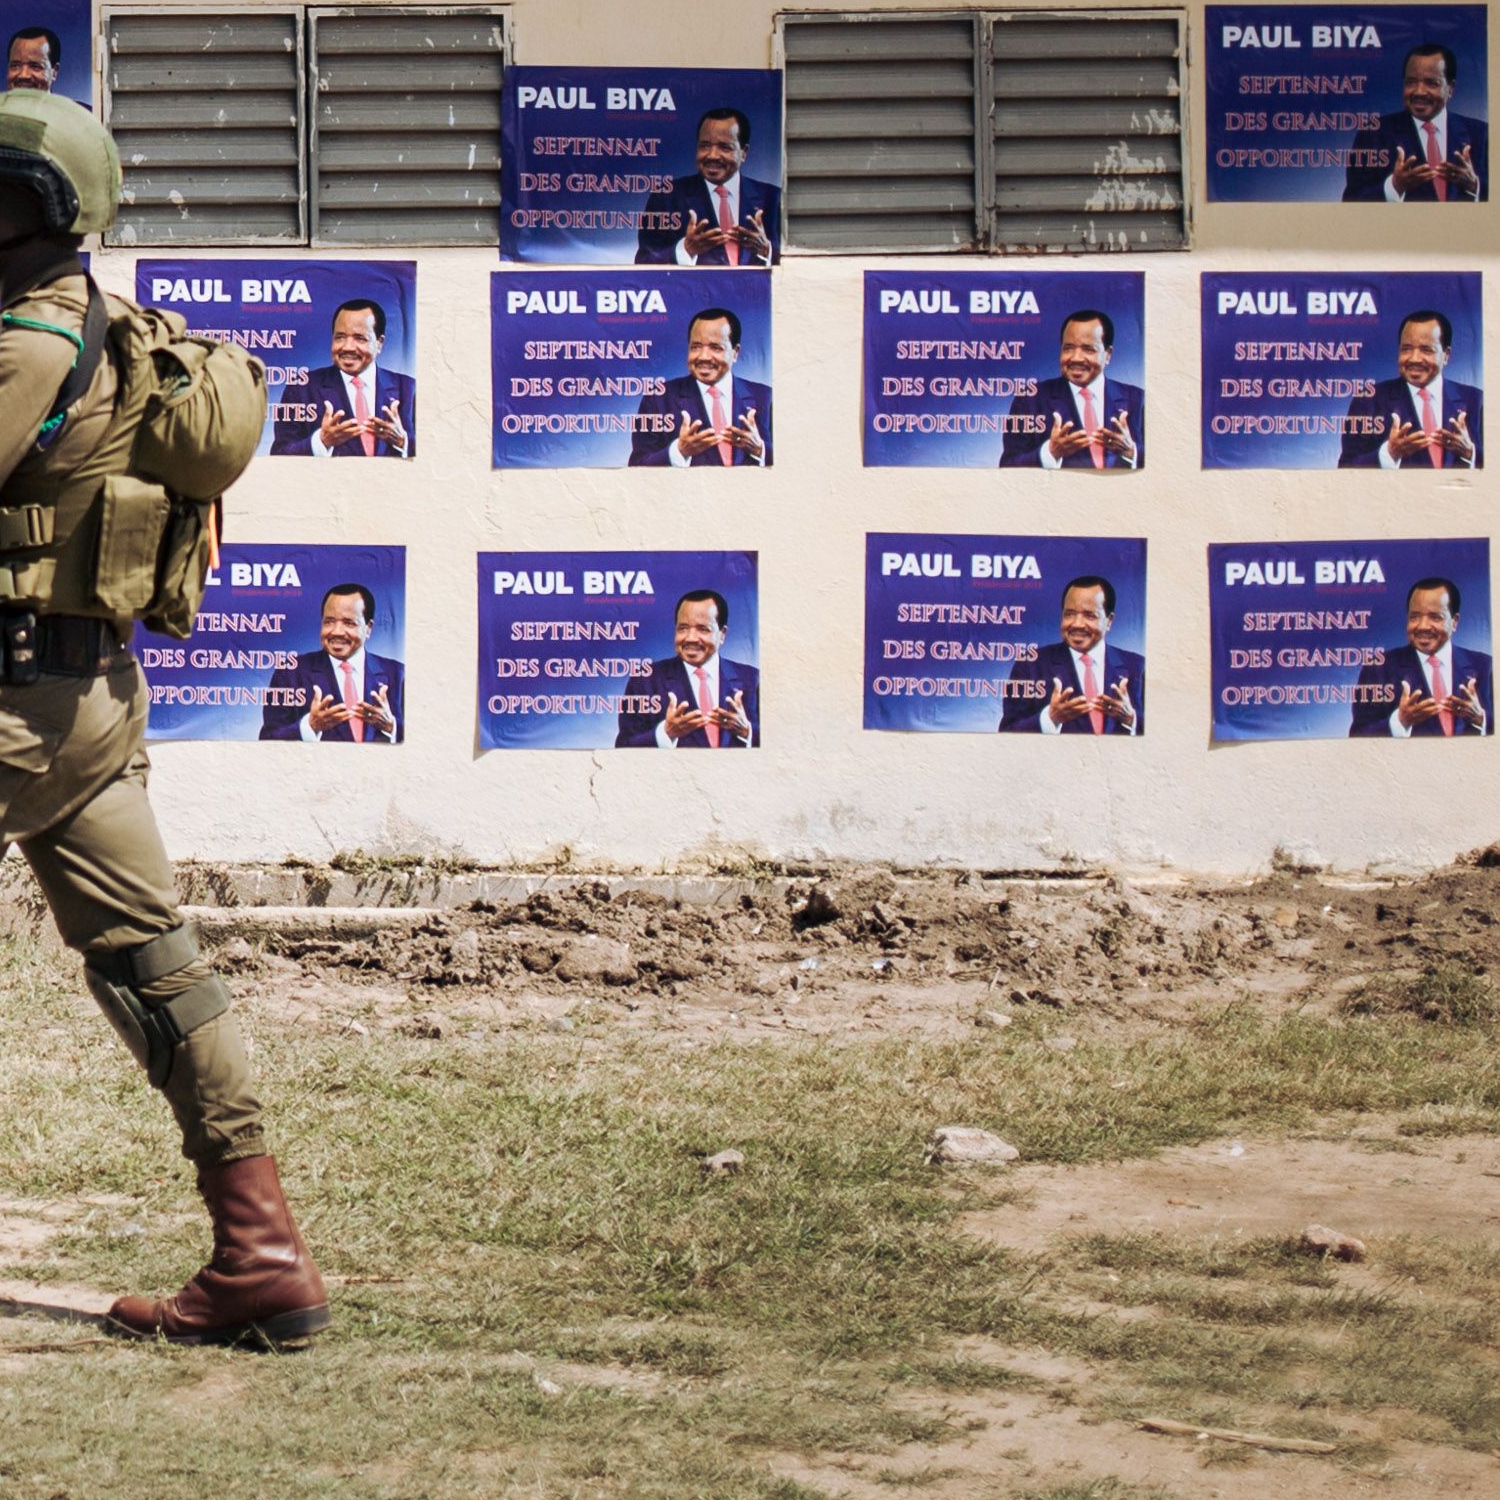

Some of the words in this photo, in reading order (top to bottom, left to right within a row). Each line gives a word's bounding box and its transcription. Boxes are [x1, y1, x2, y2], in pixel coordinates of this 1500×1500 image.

[1222, 25, 1301, 48] PAUL
[1311, 25, 1381, 48] BIYA
[1239, 75, 1366, 94] SEPTENNAT
[517, 85, 596, 110] PAUL
[606, 87, 675, 111] BIYA
[1224, 111, 1266, 130] DES
[1272, 112, 1380, 131] GRANDES
[533, 135, 660, 157] SEPTENNAT
[1215, 148, 1389, 167] OPPORTUNITES
[518, 172, 560, 192] DES
[565, 173, 673, 194] GRANDES
[508, 208, 681, 230] OPPORTUNITES
[152, 278, 231, 302] PAUL
[241, 279, 310, 303] BIYA
[880, 289, 959, 313] PAUL
[970, 290, 1039, 314] BIYA
[507, 290, 586, 314] PAUL
[596, 290, 666, 313] BIYA
[1217, 291, 1297, 314] PAUL
[1307, 291, 1376, 315] BIYA
[524, 340, 651, 360] SEPTENNAT
[896, 339, 1024, 360] SEPTENNAT
[1234, 341, 1362, 361] SEPTENNAT
[510, 377, 552, 396] DES
[557, 377, 665, 396] GRANDES
[881, 376, 923, 396] DES
[929, 377, 1037, 397] GRANDES
[1220, 378, 1262, 397] DES
[1267, 378, 1375, 397] GRANDES
[501, 413, 675, 433] OPPORTUNITES
[872, 413, 1046, 433] OPPORTUNITES
[1210, 415, 1384, 434] OPPORTUNITES
[231, 563, 300, 587] BIYA
[882, 552, 961, 577] PAUL
[971, 554, 1040, 579] BIYA
[1225, 561, 1305, 585] PAUL
[1315, 559, 1384, 584] BIYA
[494, 571, 573, 594] PAUL
[584, 571, 653, 594] BIYA
[898, 602, 1025, 625] SEPTENNAT
[1243, 610, 1371, 631] SEPTENNAT
[511, 621, 638, 640] SEPTENNAT
[143, 648, 185, 668] DES
[190, 649, 297, 670] GRANDES
[882, 639, 924, 659] DES
[930, 640, 1038, 662] GRANDES
[1229, 648, 1271, 668] DES
[1276, 647, 1385, 667] GRANDES
[496, 658, 538, 677] DES
[544, 658, 652, 677] GRANDES
[872, 675, 1046, 699] OPPORTUNITES
[1220, 683, 1395, 705] OPPORTUNITES
[487, 695, 661, 713] OPPORTUNITES
